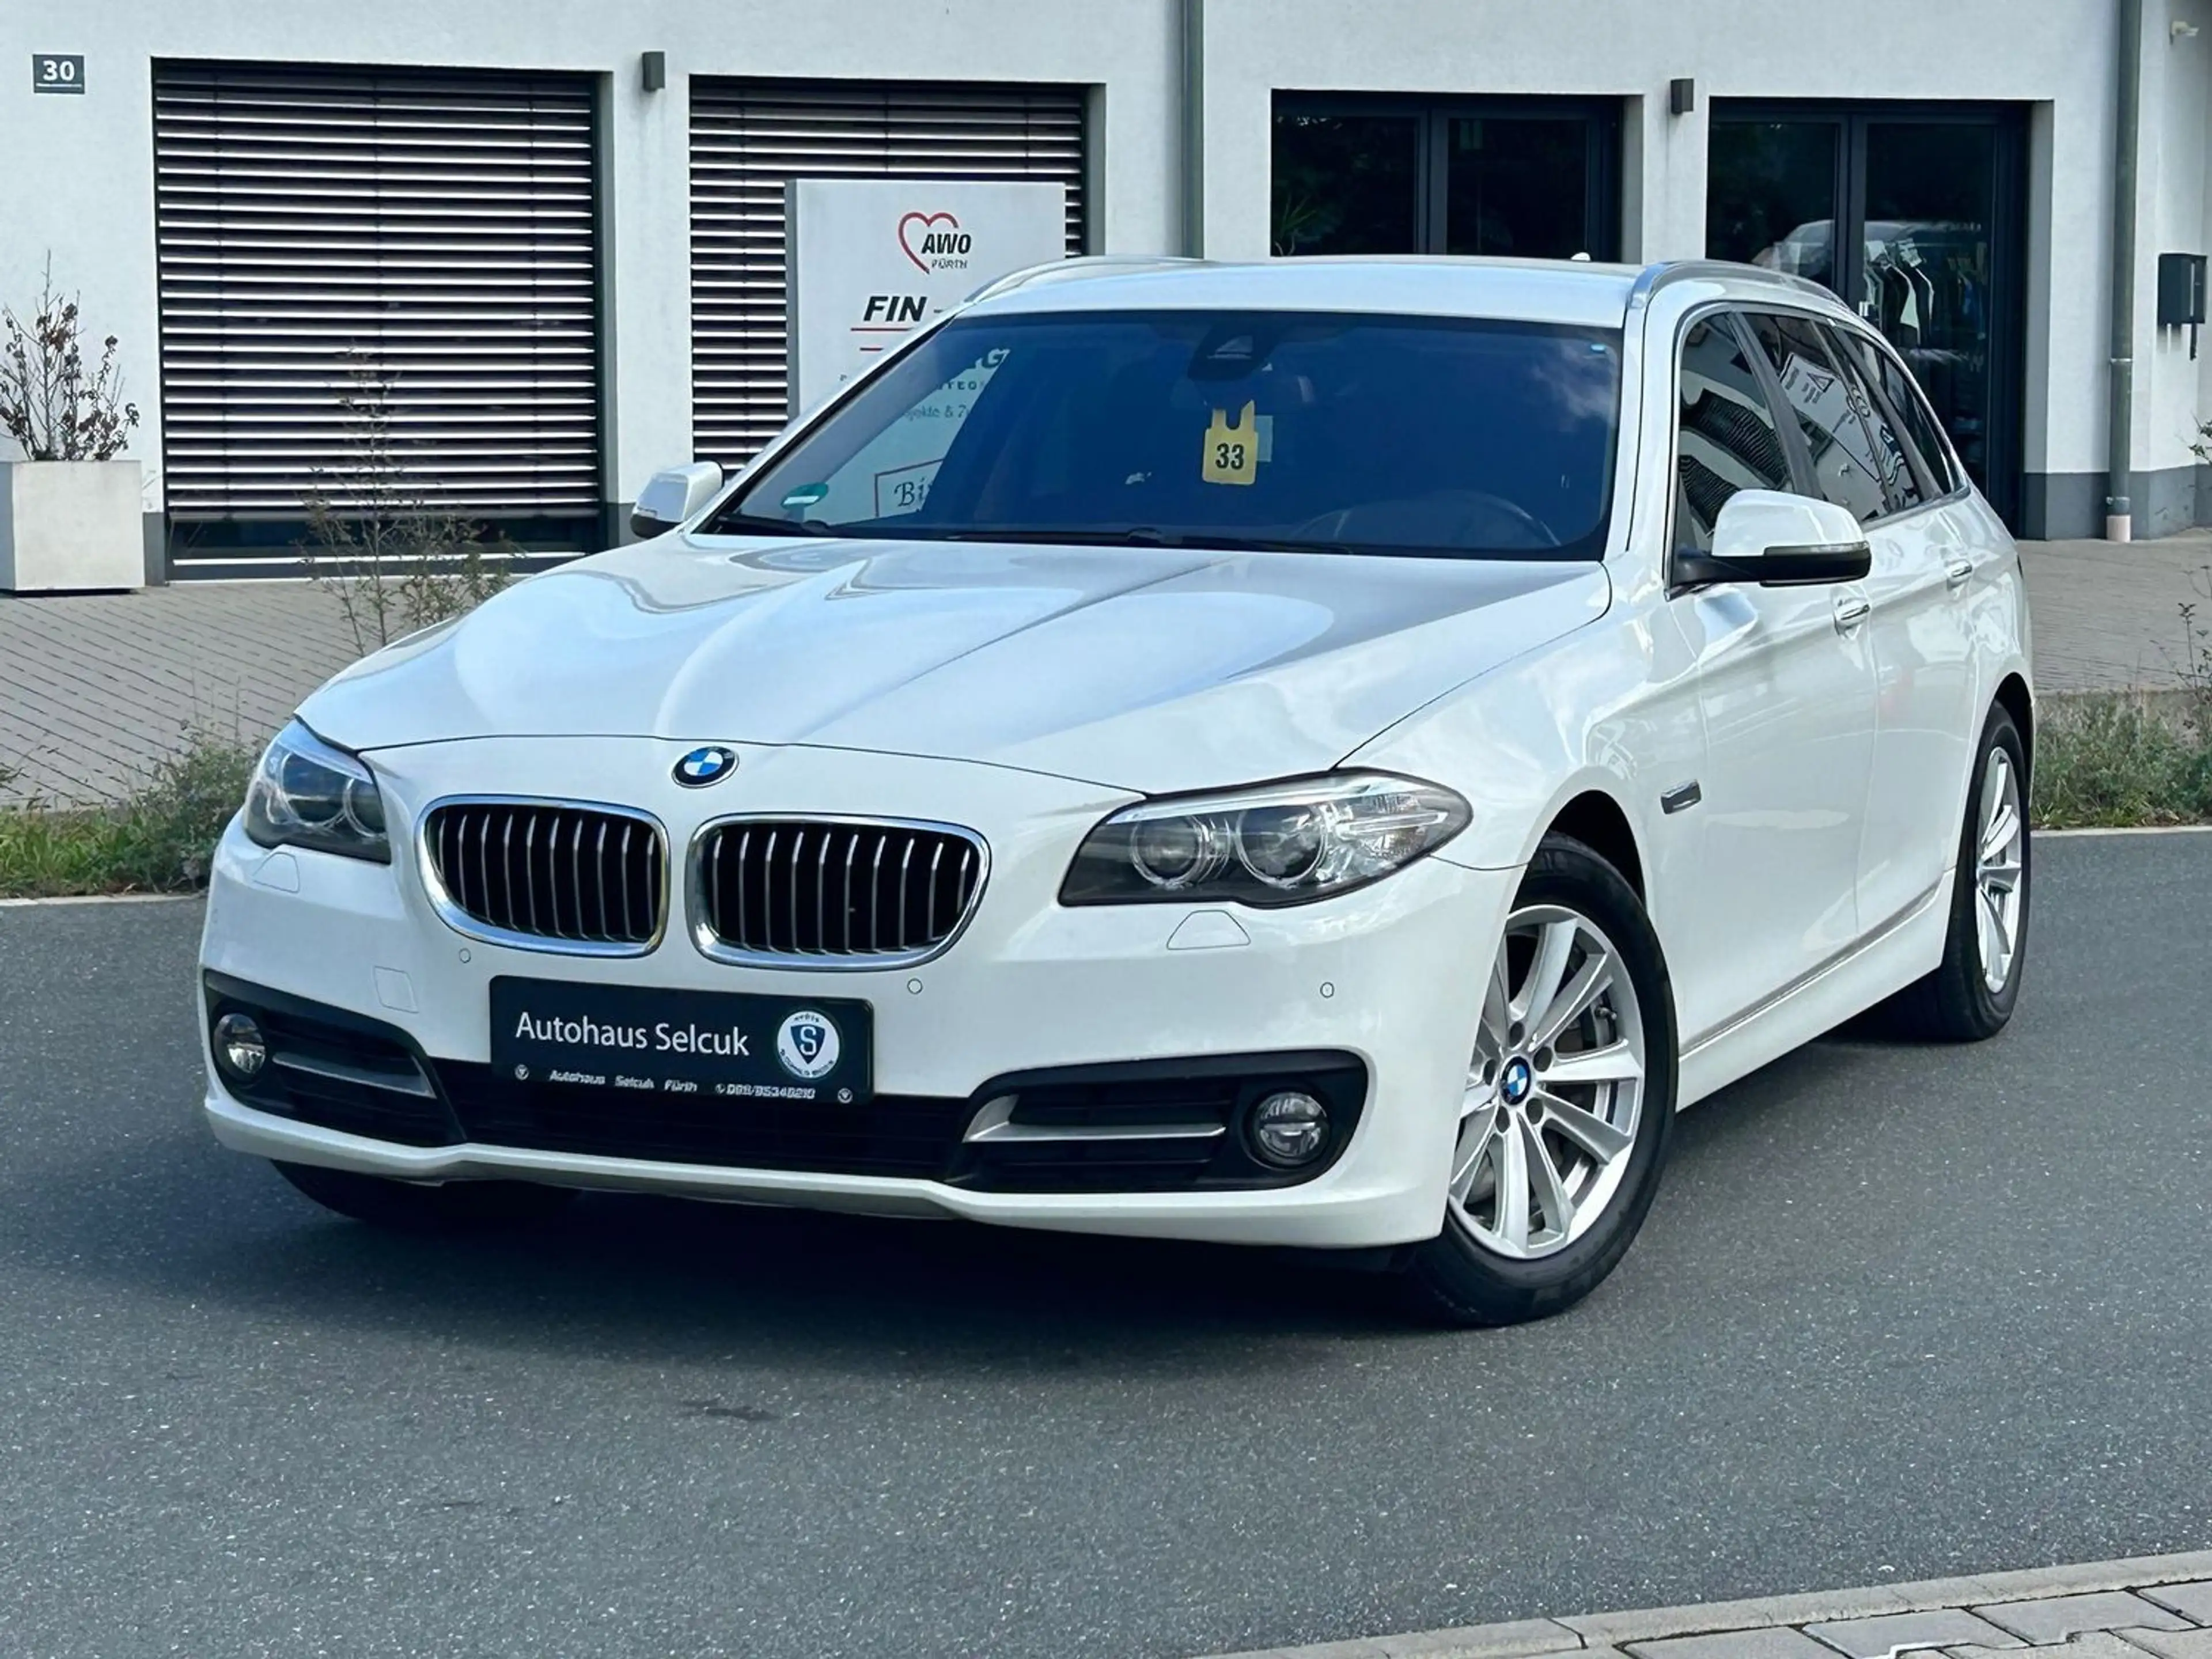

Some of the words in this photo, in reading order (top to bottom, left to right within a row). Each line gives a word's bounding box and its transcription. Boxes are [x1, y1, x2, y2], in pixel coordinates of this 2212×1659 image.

[42, 59, 75, 81] 30
[921, 233, 971, 255] AWO
[1215, 442, 1244, 470] 33
[516, 1012, 647, 1049] Autohaus
[655, 1022, 749, 1056] Selcuk
